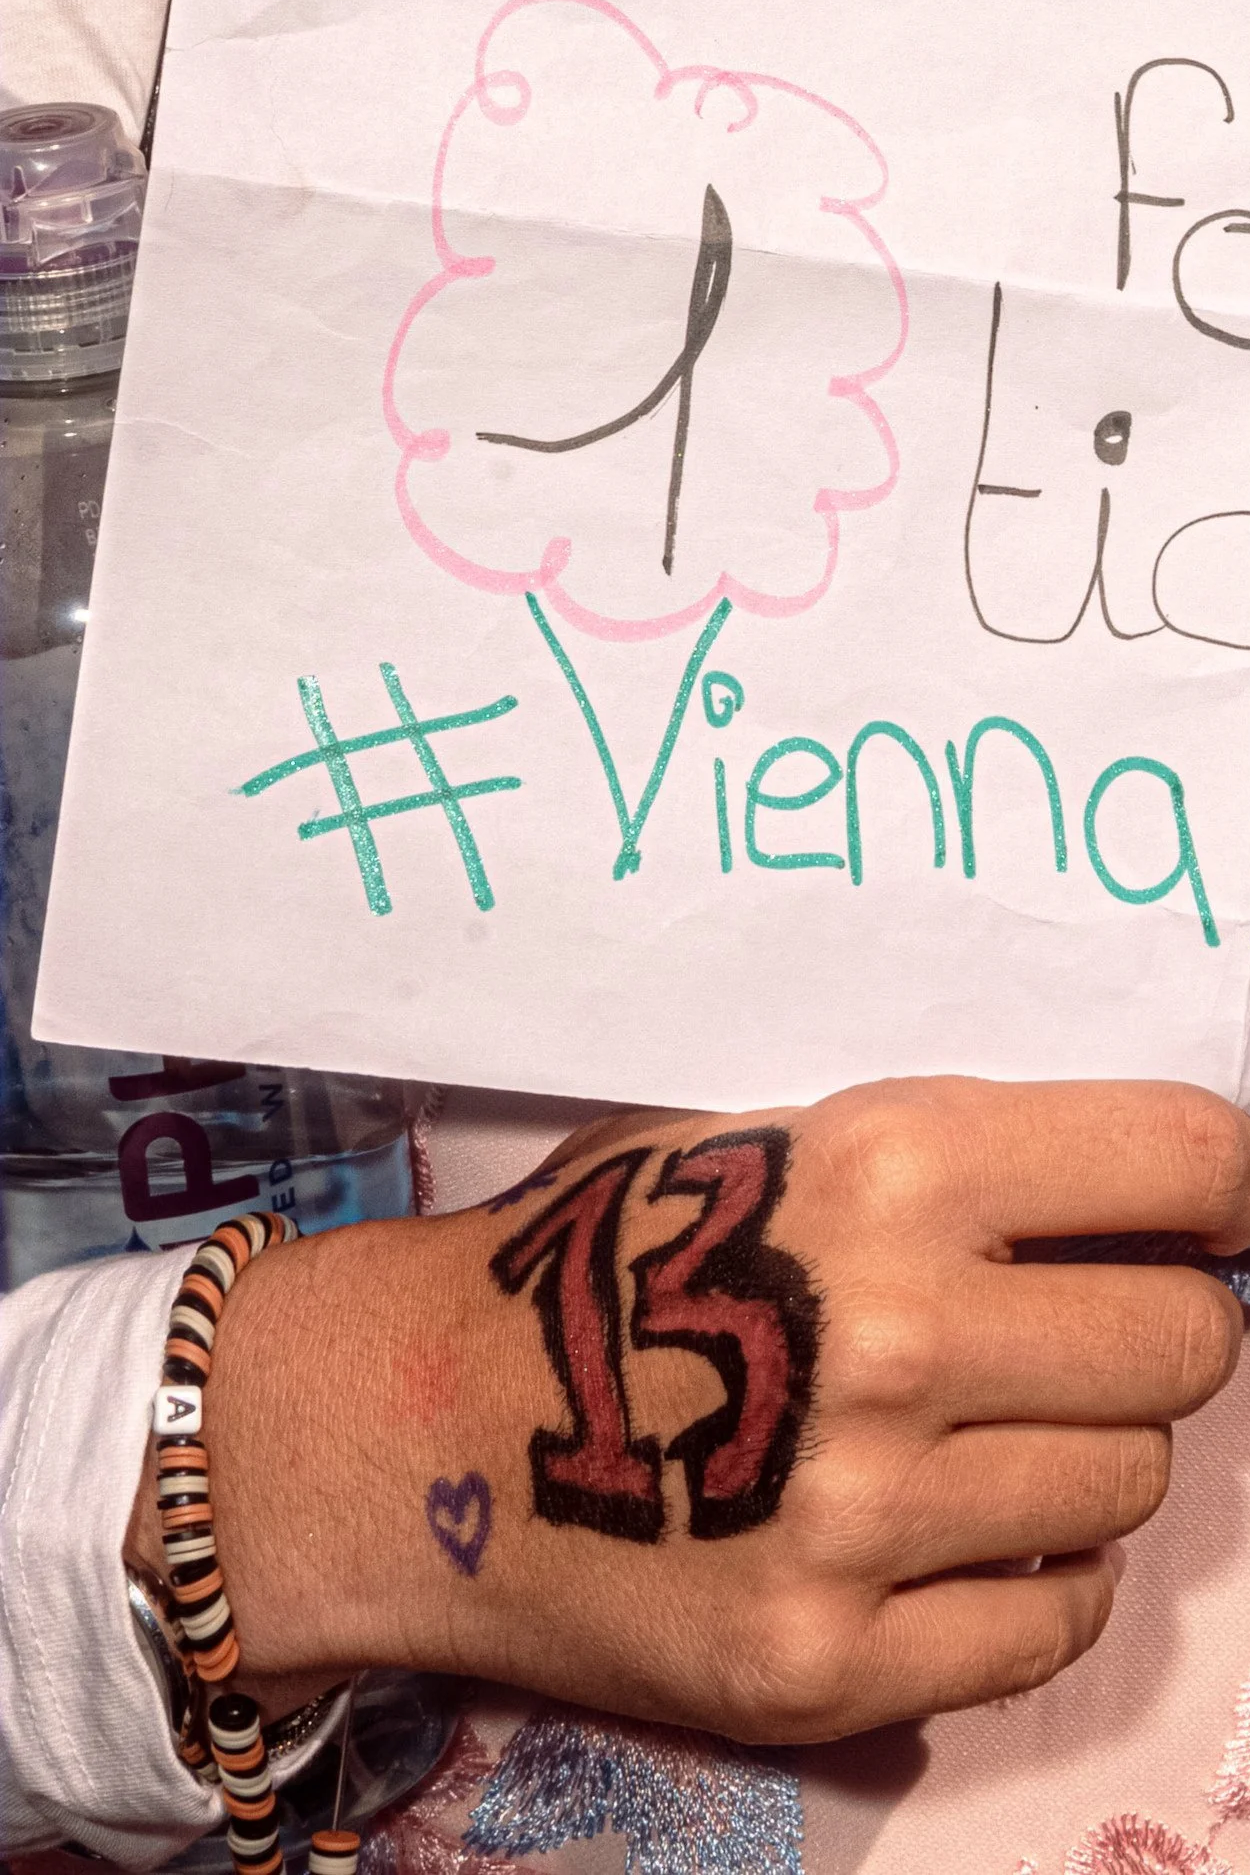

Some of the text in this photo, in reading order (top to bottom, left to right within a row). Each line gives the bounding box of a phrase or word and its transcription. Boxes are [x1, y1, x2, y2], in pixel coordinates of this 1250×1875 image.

[474, 182, 734, 576] 1
[166, 1395, 198, 1424] A
[487, 1124, 827, 1546] 13
